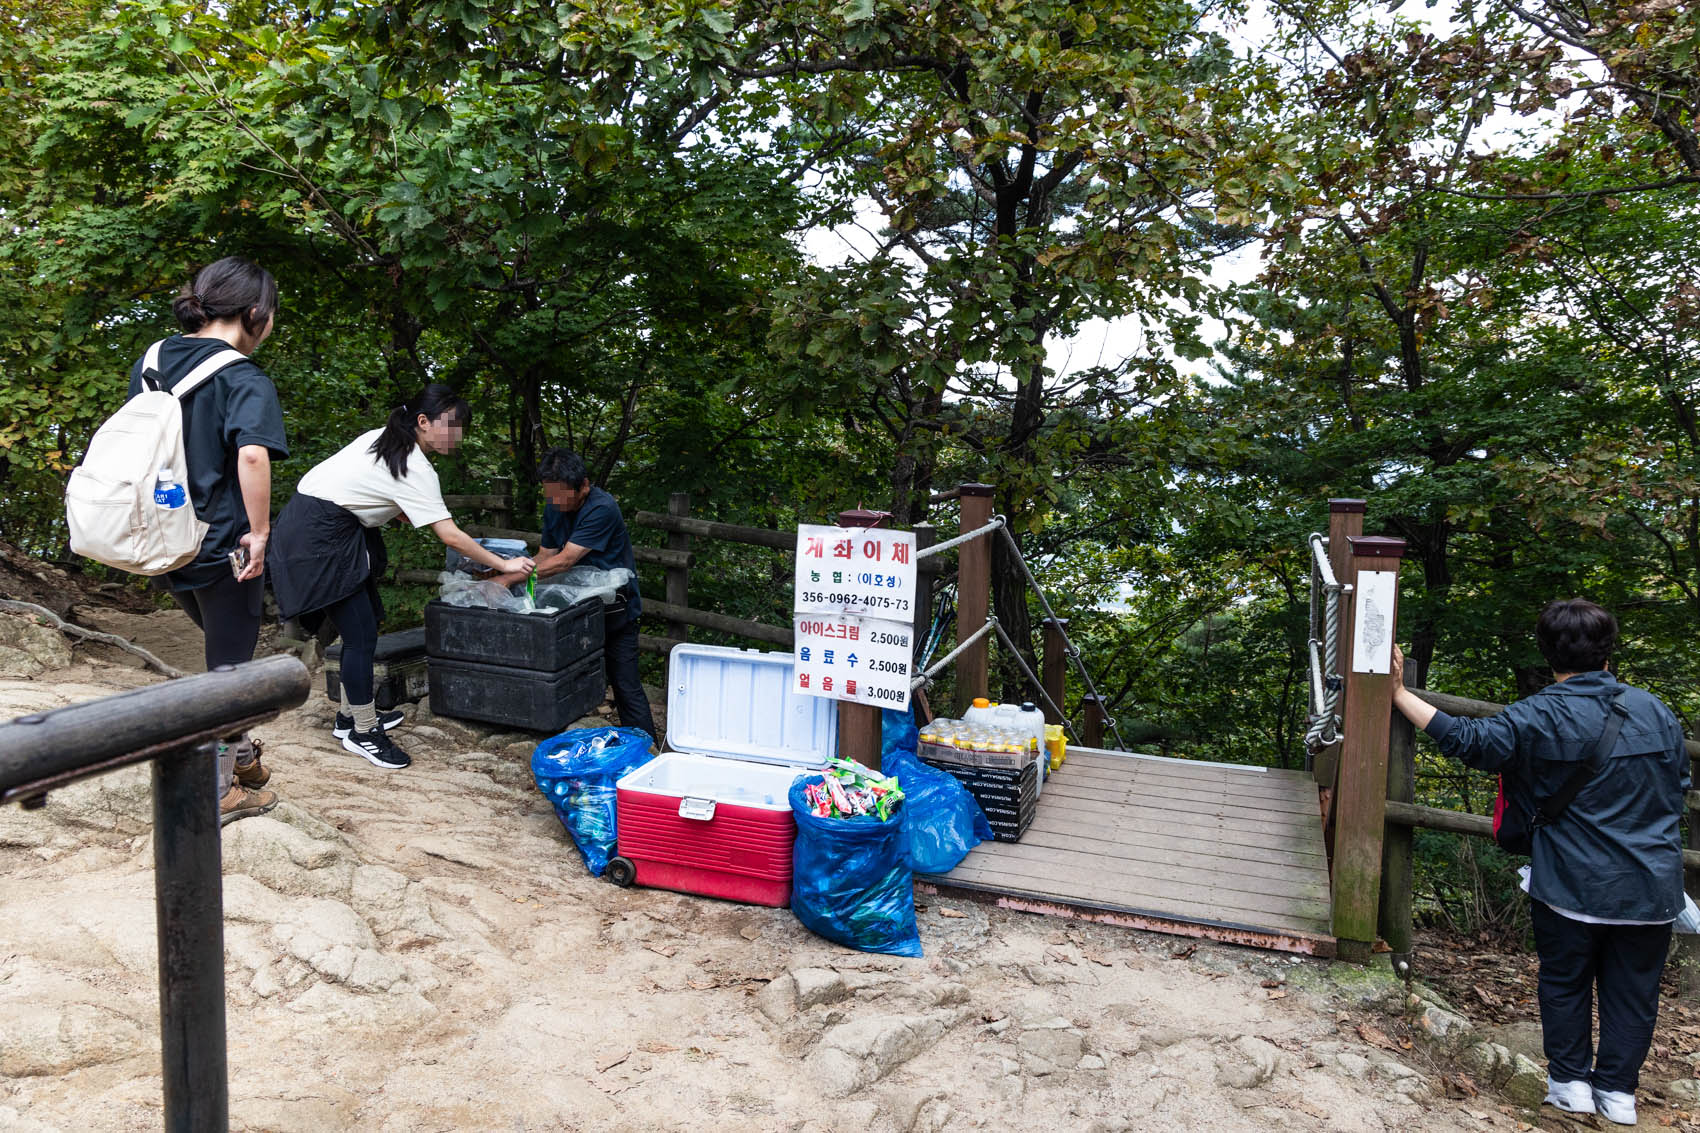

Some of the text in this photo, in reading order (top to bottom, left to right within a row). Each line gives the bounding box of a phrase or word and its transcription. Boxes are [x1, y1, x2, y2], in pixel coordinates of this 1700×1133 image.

[858, 573, 902, 589] (이호성)
[802, 592, 908, 611] 356-0962-4075-73
[800, 620, 909, 647] 아이스크림 2,500원
[869, 659, 907, 675] 2,500원
[867, 686, 905, 703] 3,000원
